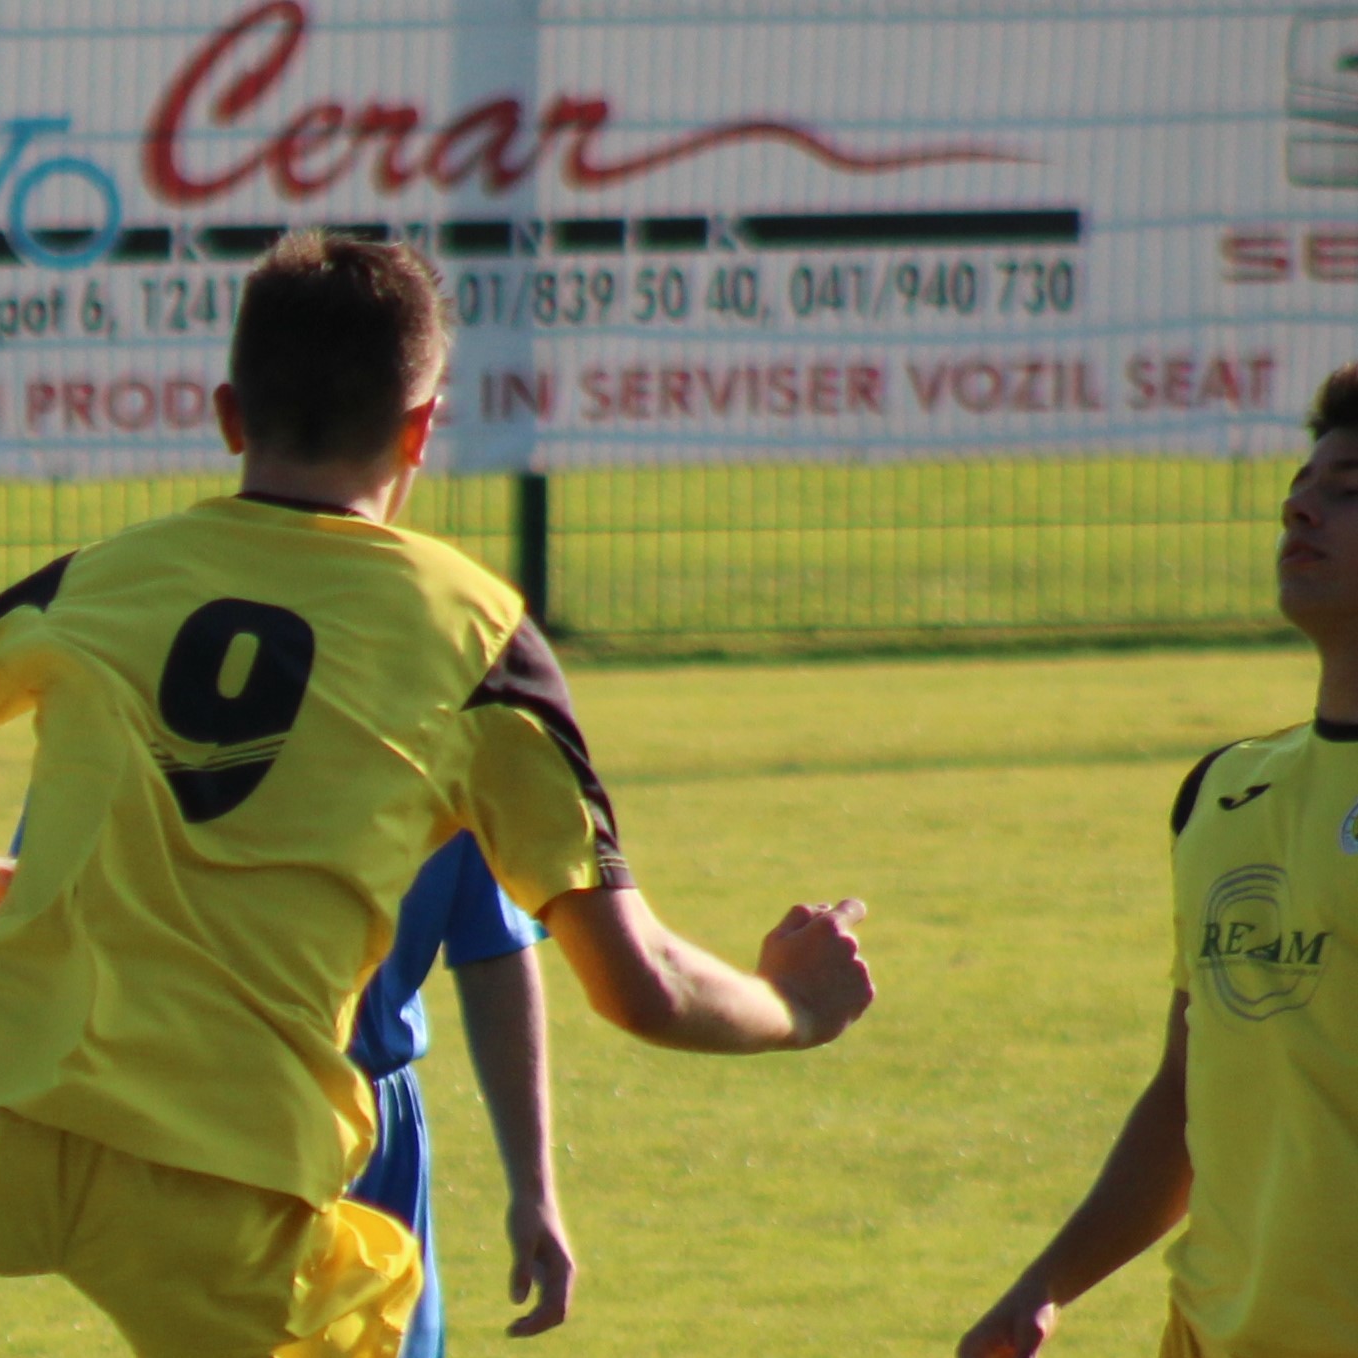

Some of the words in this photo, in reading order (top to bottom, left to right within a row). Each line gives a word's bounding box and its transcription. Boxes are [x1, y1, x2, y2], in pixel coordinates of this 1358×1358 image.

[142, 0, 1051, 207] Cerar
[456, 268, 616, 326] 01/839
[635, 266, 687, 321] 50
[790, 261, 979, 320] 041/940
[992, 258, 1075, 313] 730
[24, 377, 216, 430] PROD
[480, 371, 555, 423] IN
[581, 365, 882, 420] SERVISER
[907, 358, 1100, 414] VOZIL
[1126, 354, 1275, 411] SEAT
[158, 597, 316, 825] 9
